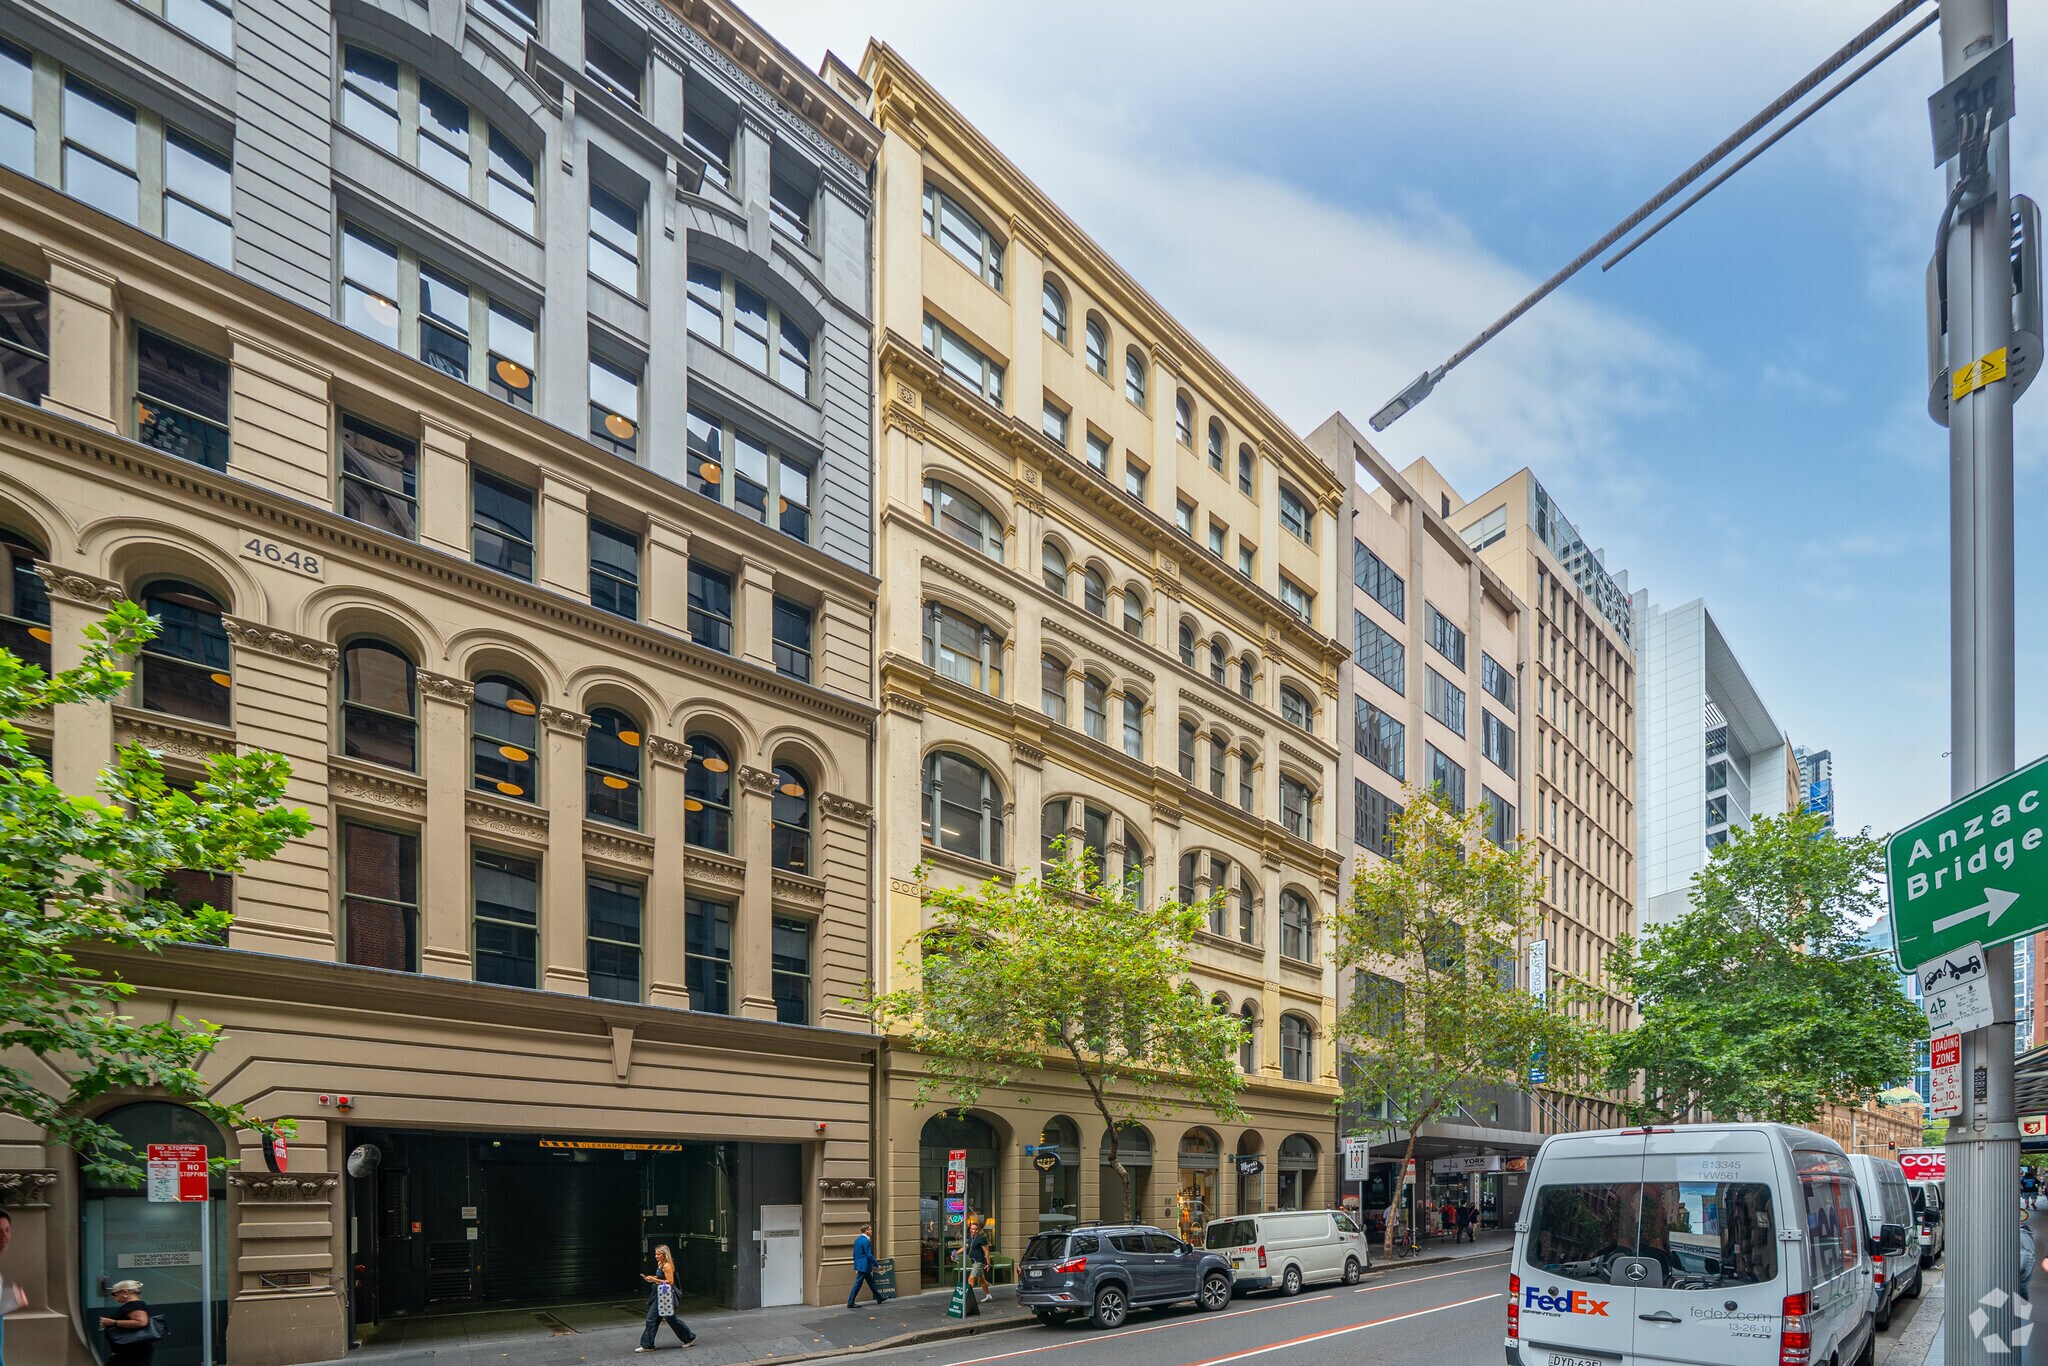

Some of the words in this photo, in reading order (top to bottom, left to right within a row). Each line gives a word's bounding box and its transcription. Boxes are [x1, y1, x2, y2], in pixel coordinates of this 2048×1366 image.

[1908, 790, 2040, 868] Anzac
[1907, 828, 2043, 901] Bridge
[1930, 999, 1946, 1015] 4P
[1932, 1036, 1958, 1053] LOADING
[1936, 1051, 1956, 1066] ZONE
[1935, 1066, 1956, 1076] TICKET
[1975, 1072, 1985, 1095] SY18128
[1901, 1154, 1945, 1166] cole
[1052, 1199, 1064, 1207] 50
[1526, 1286, 1610, 1317] FedEx
[1690, 1306, 1772, 1322] fedex.com
[1729, 1323, 1771, 1333] 13-26-10
